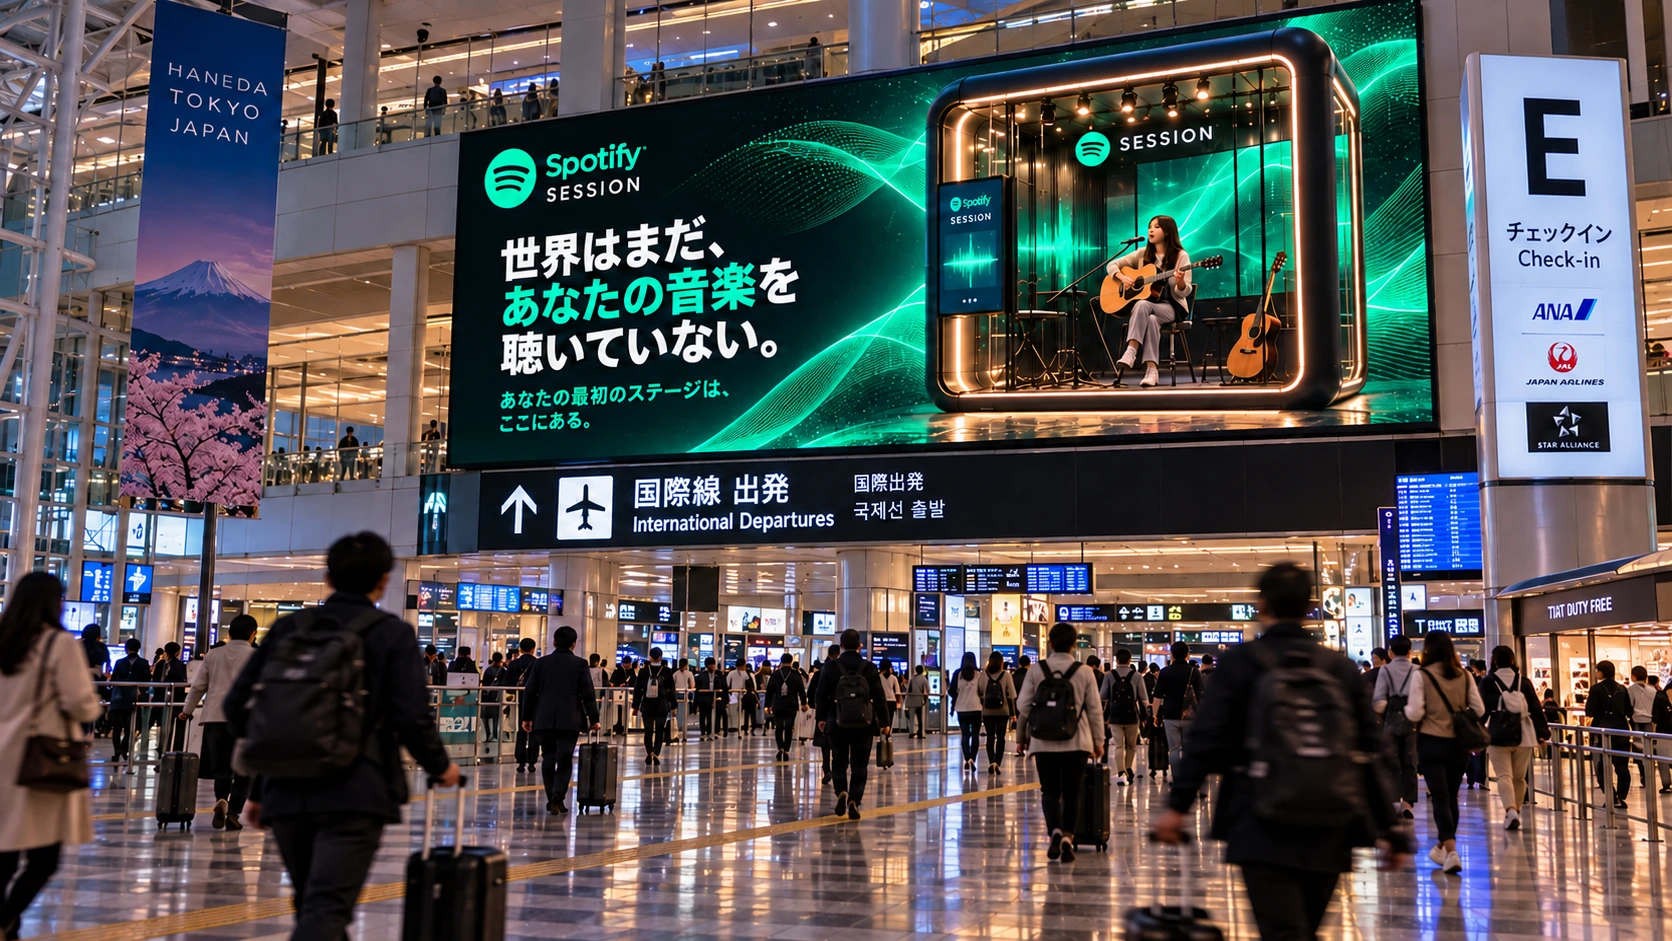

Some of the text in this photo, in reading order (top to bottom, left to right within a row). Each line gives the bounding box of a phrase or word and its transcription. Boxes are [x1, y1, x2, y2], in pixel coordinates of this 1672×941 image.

[168, 62, 268, 96] HANEDA
[169, 88, 259, 120] TOKYO
[170, 118, 249, 145] JAPAN
[1120, 125, 1213, 152] SESSION
[1524, 98, 1586, 196] E
[546, 142, 642, 180] Spotify
[546, 176, 640, 203] SESSION
[963, 194, 991, 209] Spotify
[950, 212, 991, 225] SESSION
[1507, 221, 1612, 244] チェックイン
[501, 215, 725, 282] 世界はまだ、
[1518, 249, 1601, 269] Check-in
[502, 257, 799, 327] あなたの音楽を
[1532, 303, 1573, 321] ANA
[501, 318, 778, 376] 聴いていない。
[501, 379, 729, 409] あなたの最初のステージは、
[1525, 378, 1558, 386] JAPAN
[499, 411, 590, 433] ここにある。
[1537, 441, 1600, 449] STAR ALLIANCE
[634, 472, 789, 508] 国際線 出発
[854, 472, 924, 494] 国際出発
[633, 510, 835, 533] International Departures
[853, 499, 946, 521] 국제선 출발
[1567, 600, 1589, 617] DUTY
[1590, 596, 1613, 613] FREE
